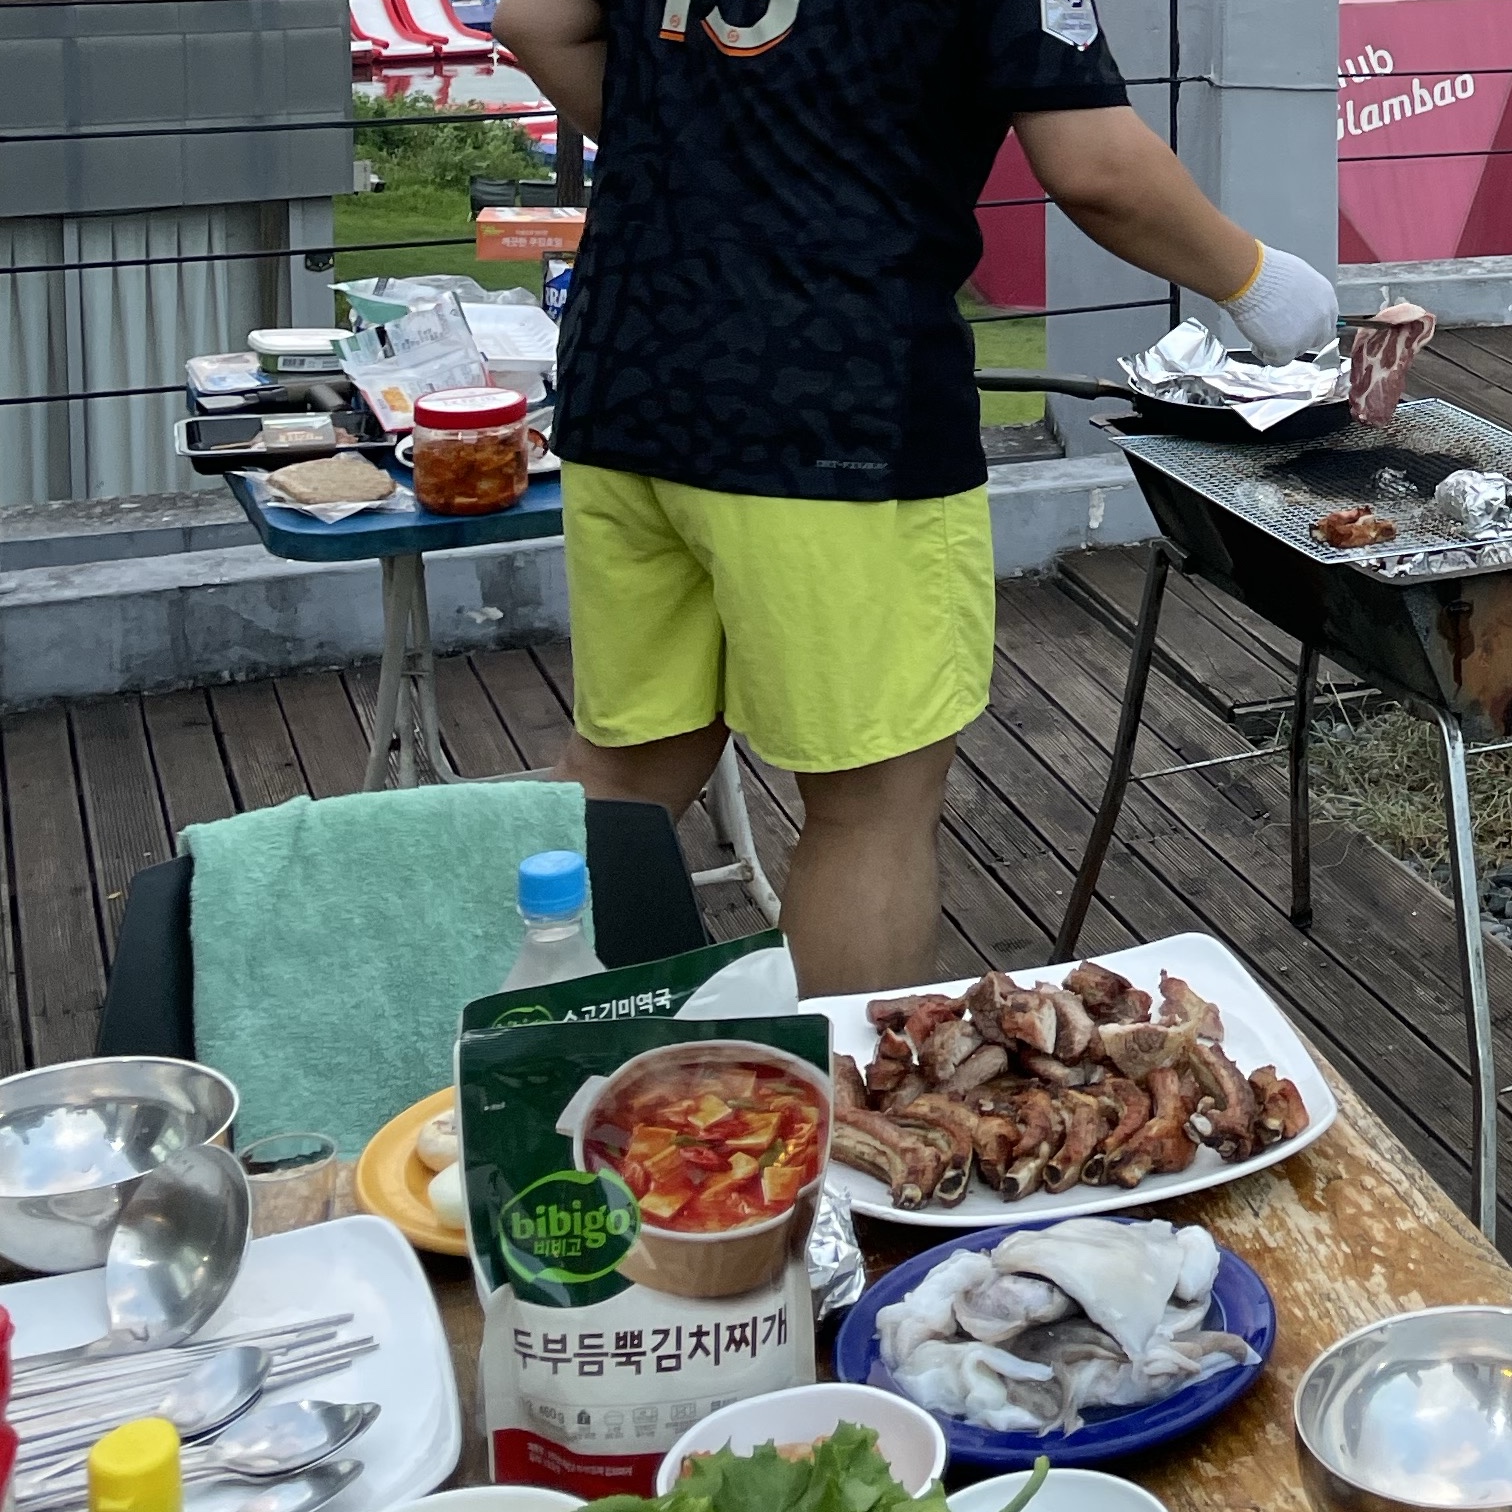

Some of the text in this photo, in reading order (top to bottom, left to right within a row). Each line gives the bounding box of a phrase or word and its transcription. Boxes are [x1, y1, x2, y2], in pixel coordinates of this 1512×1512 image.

[1337, 73, 1475, 141] lambao
[511, 1199, 631, 1249] bibigo
[533, 1238, 582, 1258] 비비고
[513, 1303, 788, 1377] 두부듬뿍김치찌개
